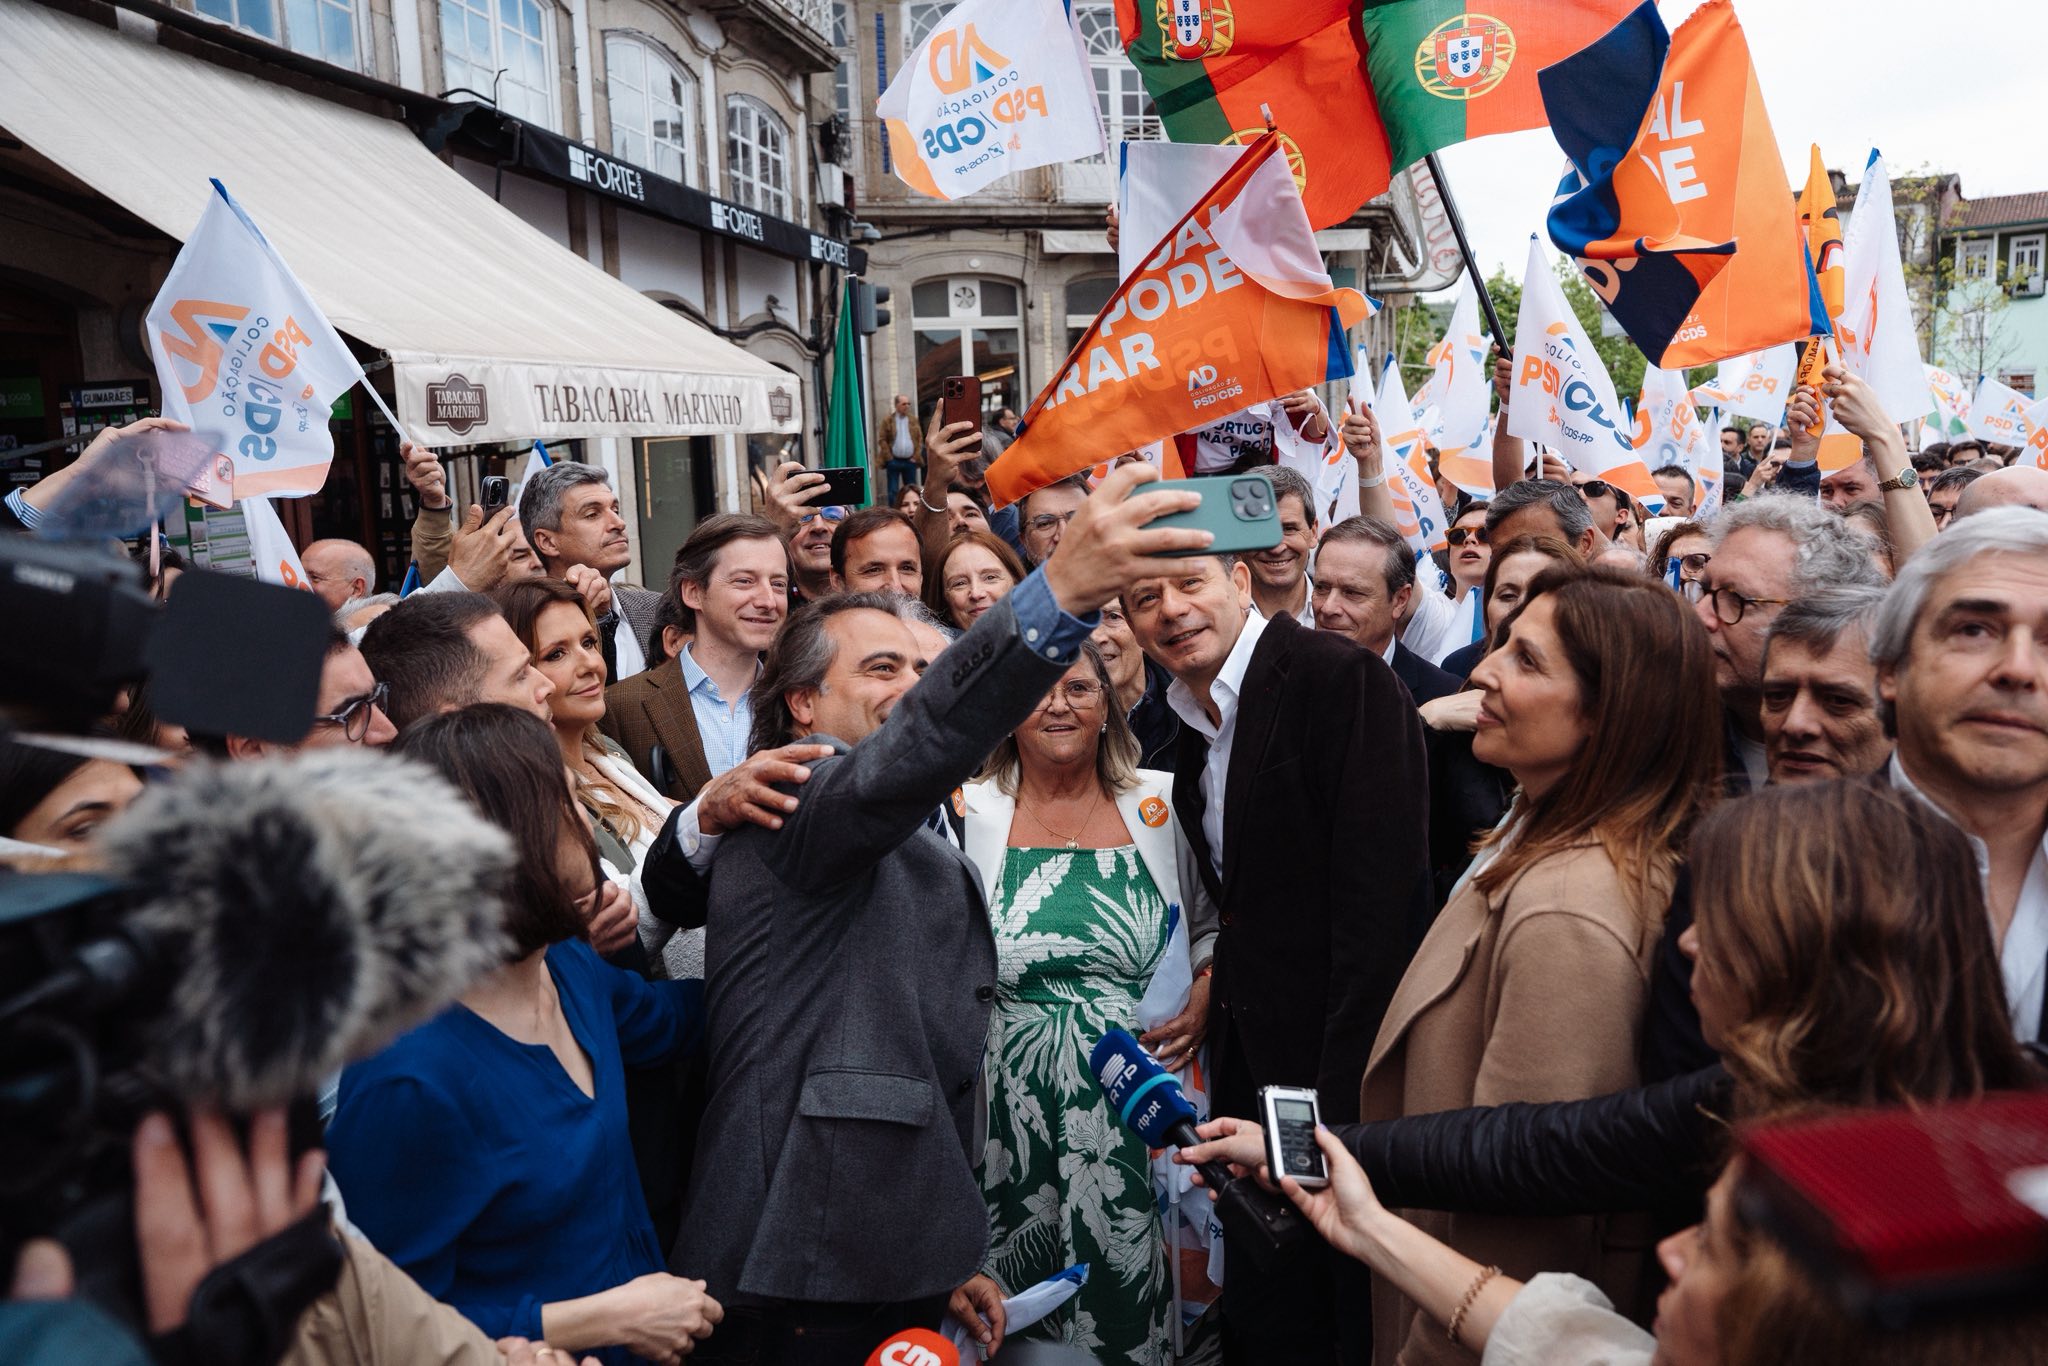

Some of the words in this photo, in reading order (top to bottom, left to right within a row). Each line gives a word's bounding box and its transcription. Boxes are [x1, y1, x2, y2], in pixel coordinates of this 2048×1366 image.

[584, 152, 639, 199] FORTE
[722, 204, 760, 241] FORTE
[820, 237, 846, 266] FORTE
[1099, 249, 1245, 338] PODE
[1043, 331, 1162, 411] RAR
[434, 388, 481, 406] TABACARIA
[436, 404, 480, 420] MARINHO
[534, 383, 655, 423] TABACARIA
[662, 391, 743, 426] MARINHO
[1192, 384, 1244, 410] PSD/CDS
[1109, 1063, 1138, 1105] RTP
[1137, 1100, 1162, 1131] rtp.pt
